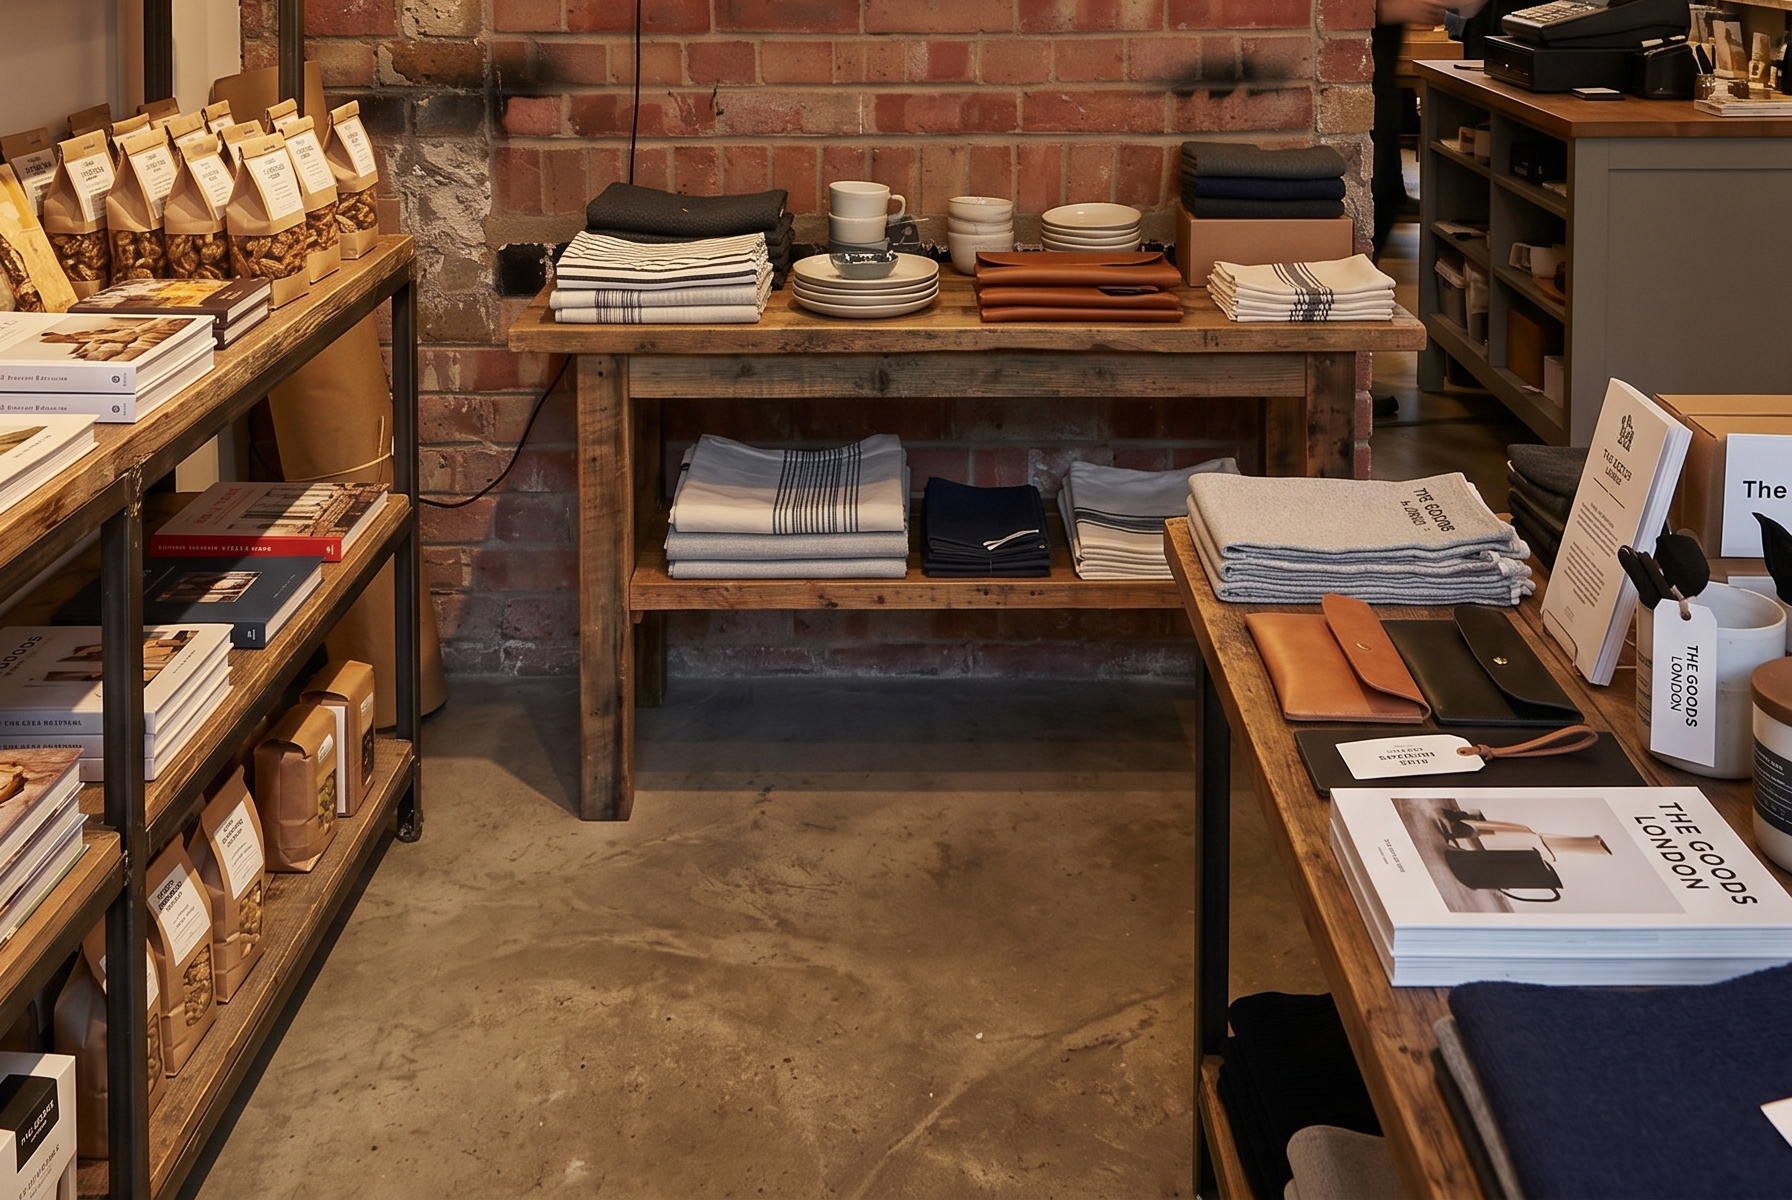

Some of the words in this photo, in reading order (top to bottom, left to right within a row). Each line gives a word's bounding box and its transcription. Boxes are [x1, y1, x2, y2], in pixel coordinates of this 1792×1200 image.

[1743, 480, 1787, 499] The
[1670, 656, 1683, 712] LONDON
[1686, 645, 1699, 672] THE
[1685, 674, 1698, 728] GOODS
[1633, 816, 1710, 889] LONDON
[1658, 802, 1702, 835] THE
[1688, 841, 1758, 905] GOODS
